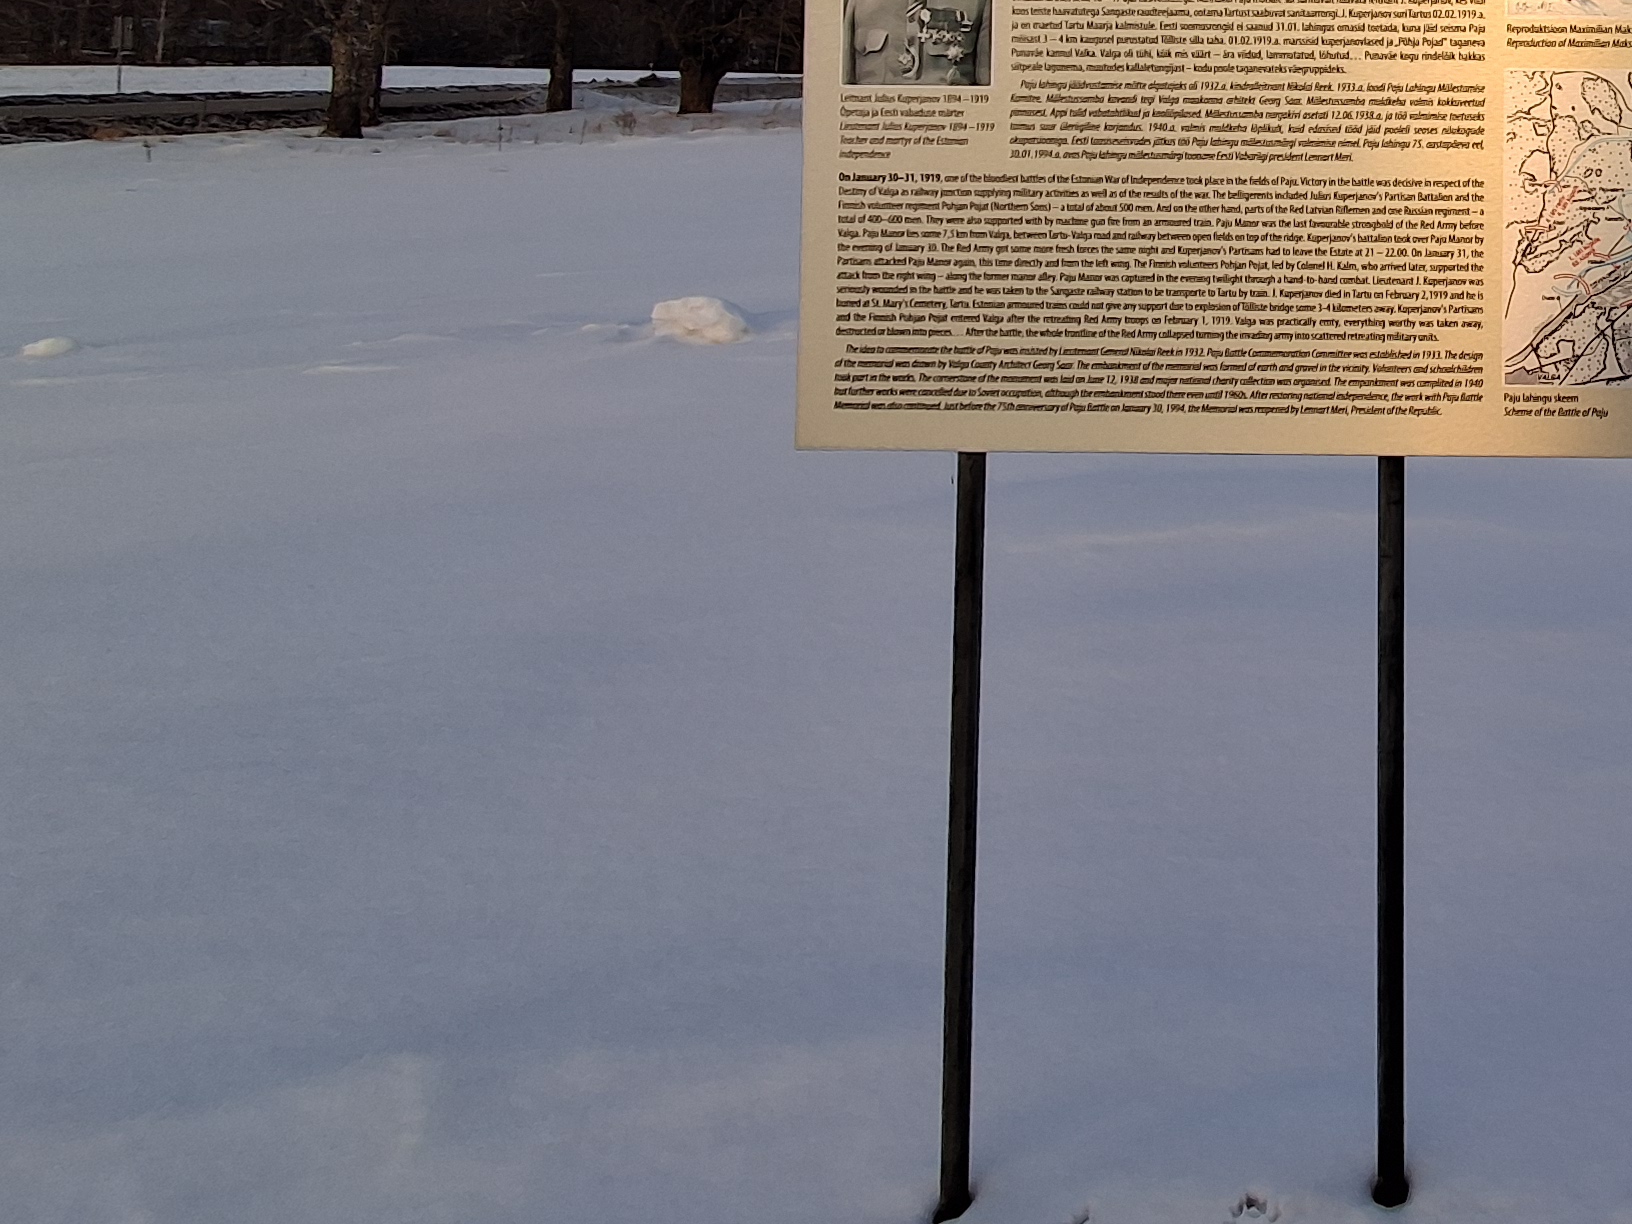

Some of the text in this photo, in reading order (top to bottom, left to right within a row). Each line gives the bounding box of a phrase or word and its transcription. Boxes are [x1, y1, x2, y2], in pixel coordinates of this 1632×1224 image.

[1558, 38, 1568, 48] of
[838, 173, 850, 182] On
[852, 173, 886, 184] January
[1249, 177, 1269, 185] fields
[1270, 177, 1278, 186] of
[1280, 177, 1298, 188] Paju.
[1300, 177, 1326, 188] Victory
[1328, 177, 1335, 186] in
[1338, 177, 1350, 186] the
[1351, 177, 1374, 186] battle
[1376, 179, 1390, 187] was
[1392, 178, 1422, 187] decisive
[1424, 178, 1431, 187] in
[1432, 179, 1460, 189] respect
[1462, 178, 1470, 187] of
[1471, 179, 1484, 187] the
[1384, 192, 1484, 201] Partisan Battalion and the
[1244, 205, 1333, 216] parts of the Red Latvian
[1351, 220, 1484, 231] stronghold of the Red Army before
[1393, 234, 1410, 243] took
[1430, 234, 1446, 245] Paju
[1448, 234, 1472, 243] Manor
[1475, 235, 1483, 246] by
[1361, 262, 1483, 273] who arrived later, supported the
[1283, 275, 1337, 284] hand-to-hand
[1436, 318, 1458, 327] taken
[1461, 320, 1484, 330] away,
[1504, 392, 1579, 405] Paju lahingu skeem
[1504, 407, 1609, 419] Scheme of the Battle of Paju
